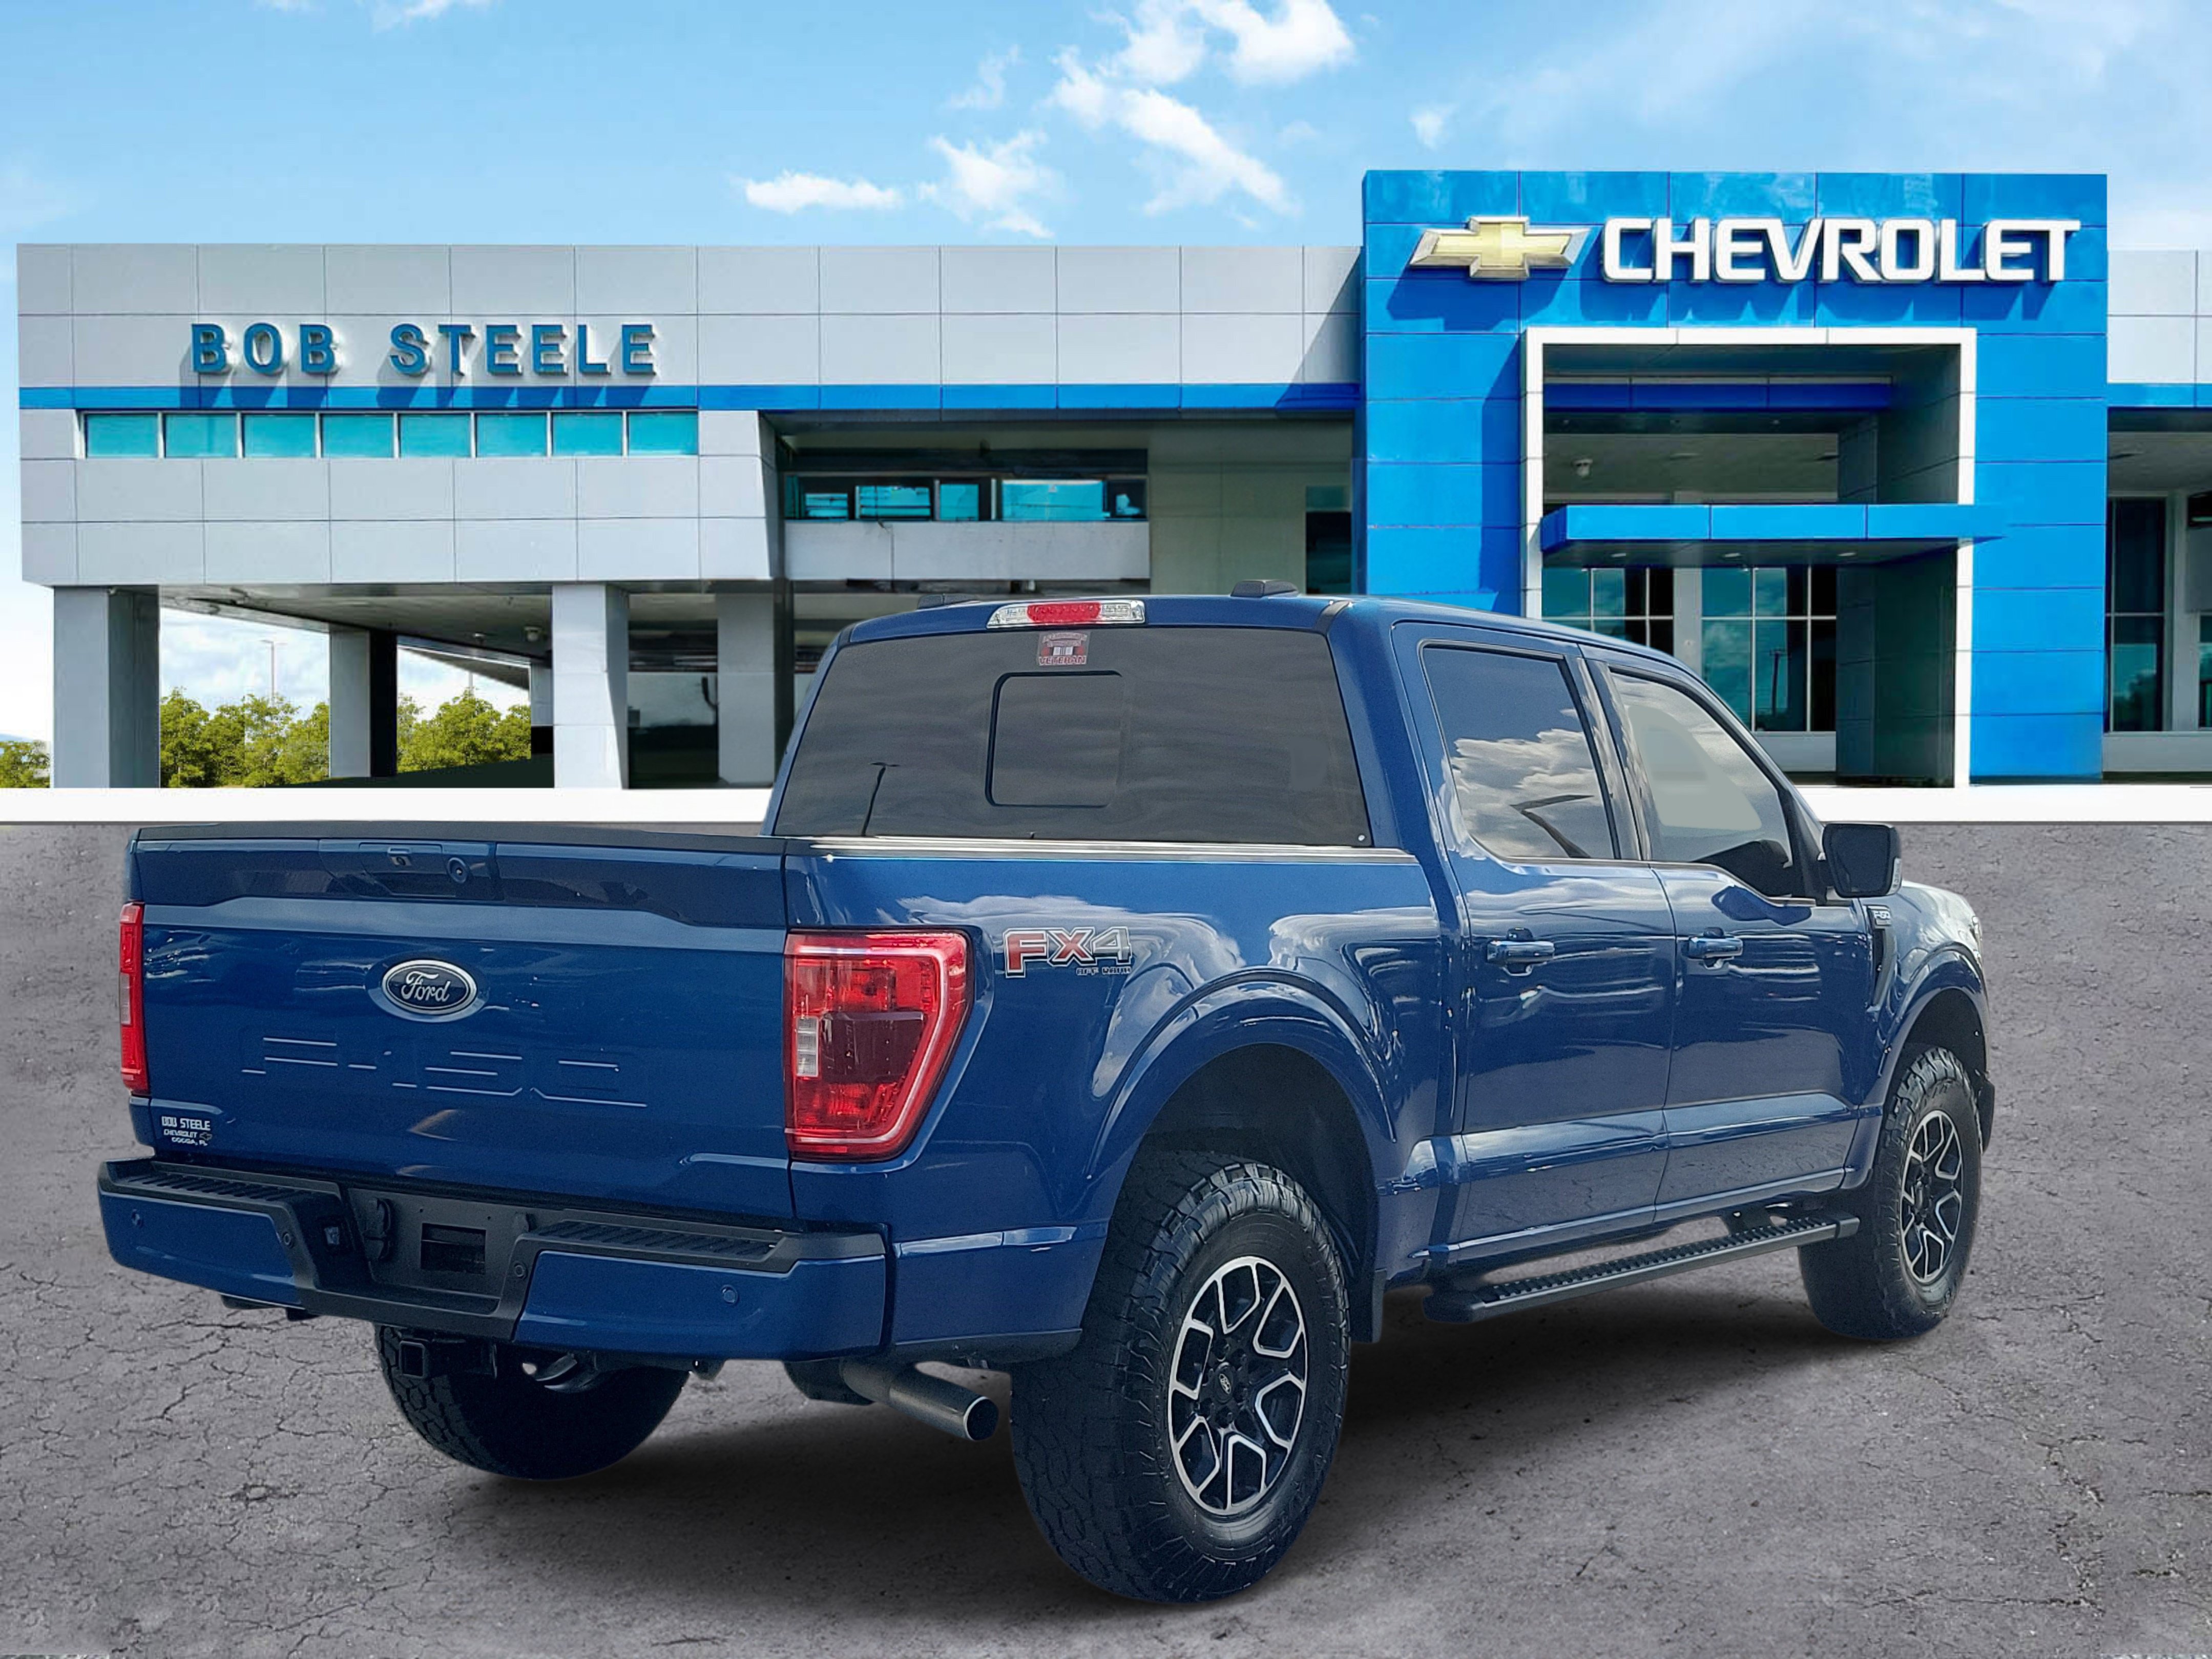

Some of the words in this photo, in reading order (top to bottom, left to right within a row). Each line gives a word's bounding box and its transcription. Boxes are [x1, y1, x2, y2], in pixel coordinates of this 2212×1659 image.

[1602, 218, 2081, 283] CHEVROLET
[191, 323, 336, 375] BOB
[389, 323, 656, 376] STEELE
[1004, 927, 1132, 978] FX4
[401, 971, 451, 1002] Ford
[180, 1118, 211, 1131] STEELE
